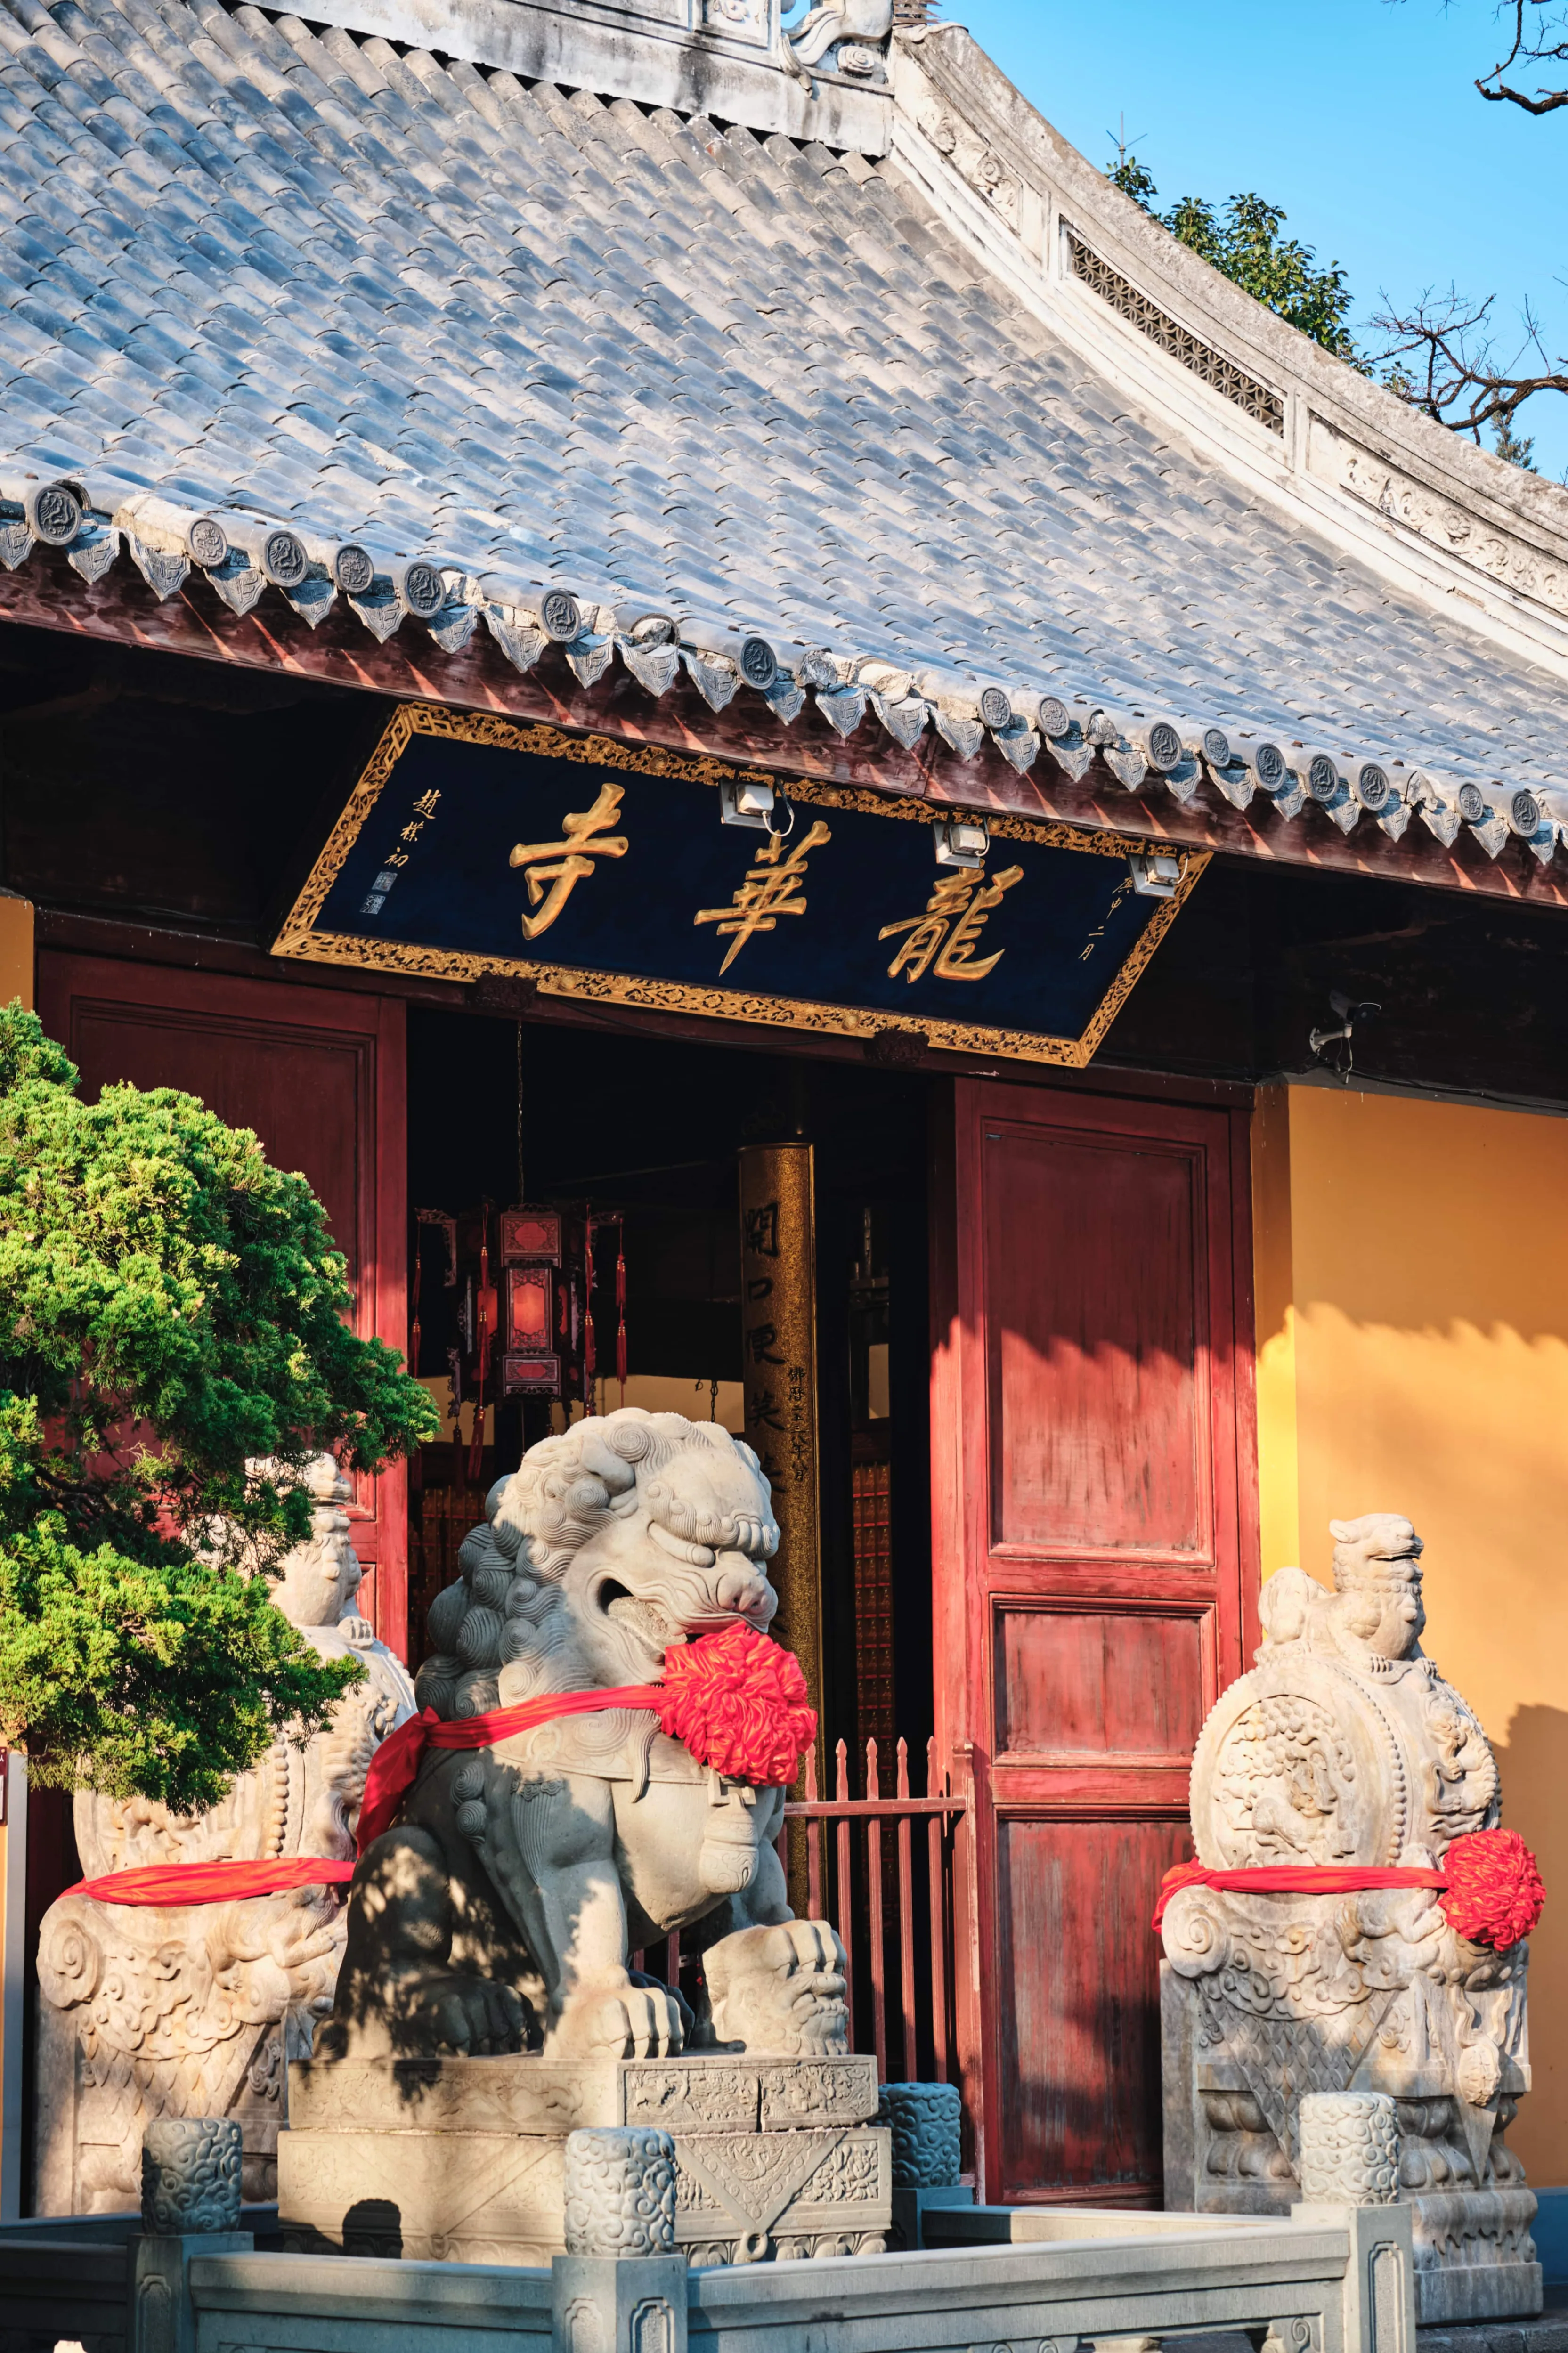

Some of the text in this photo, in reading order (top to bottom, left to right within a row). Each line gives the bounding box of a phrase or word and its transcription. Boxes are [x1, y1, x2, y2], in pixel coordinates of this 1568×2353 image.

[384, 789, 441, 868] 趙樸初
[509, 782, 1024, 983] 龍華寺
[1078, 876, 1133, 961] 庚申二月
